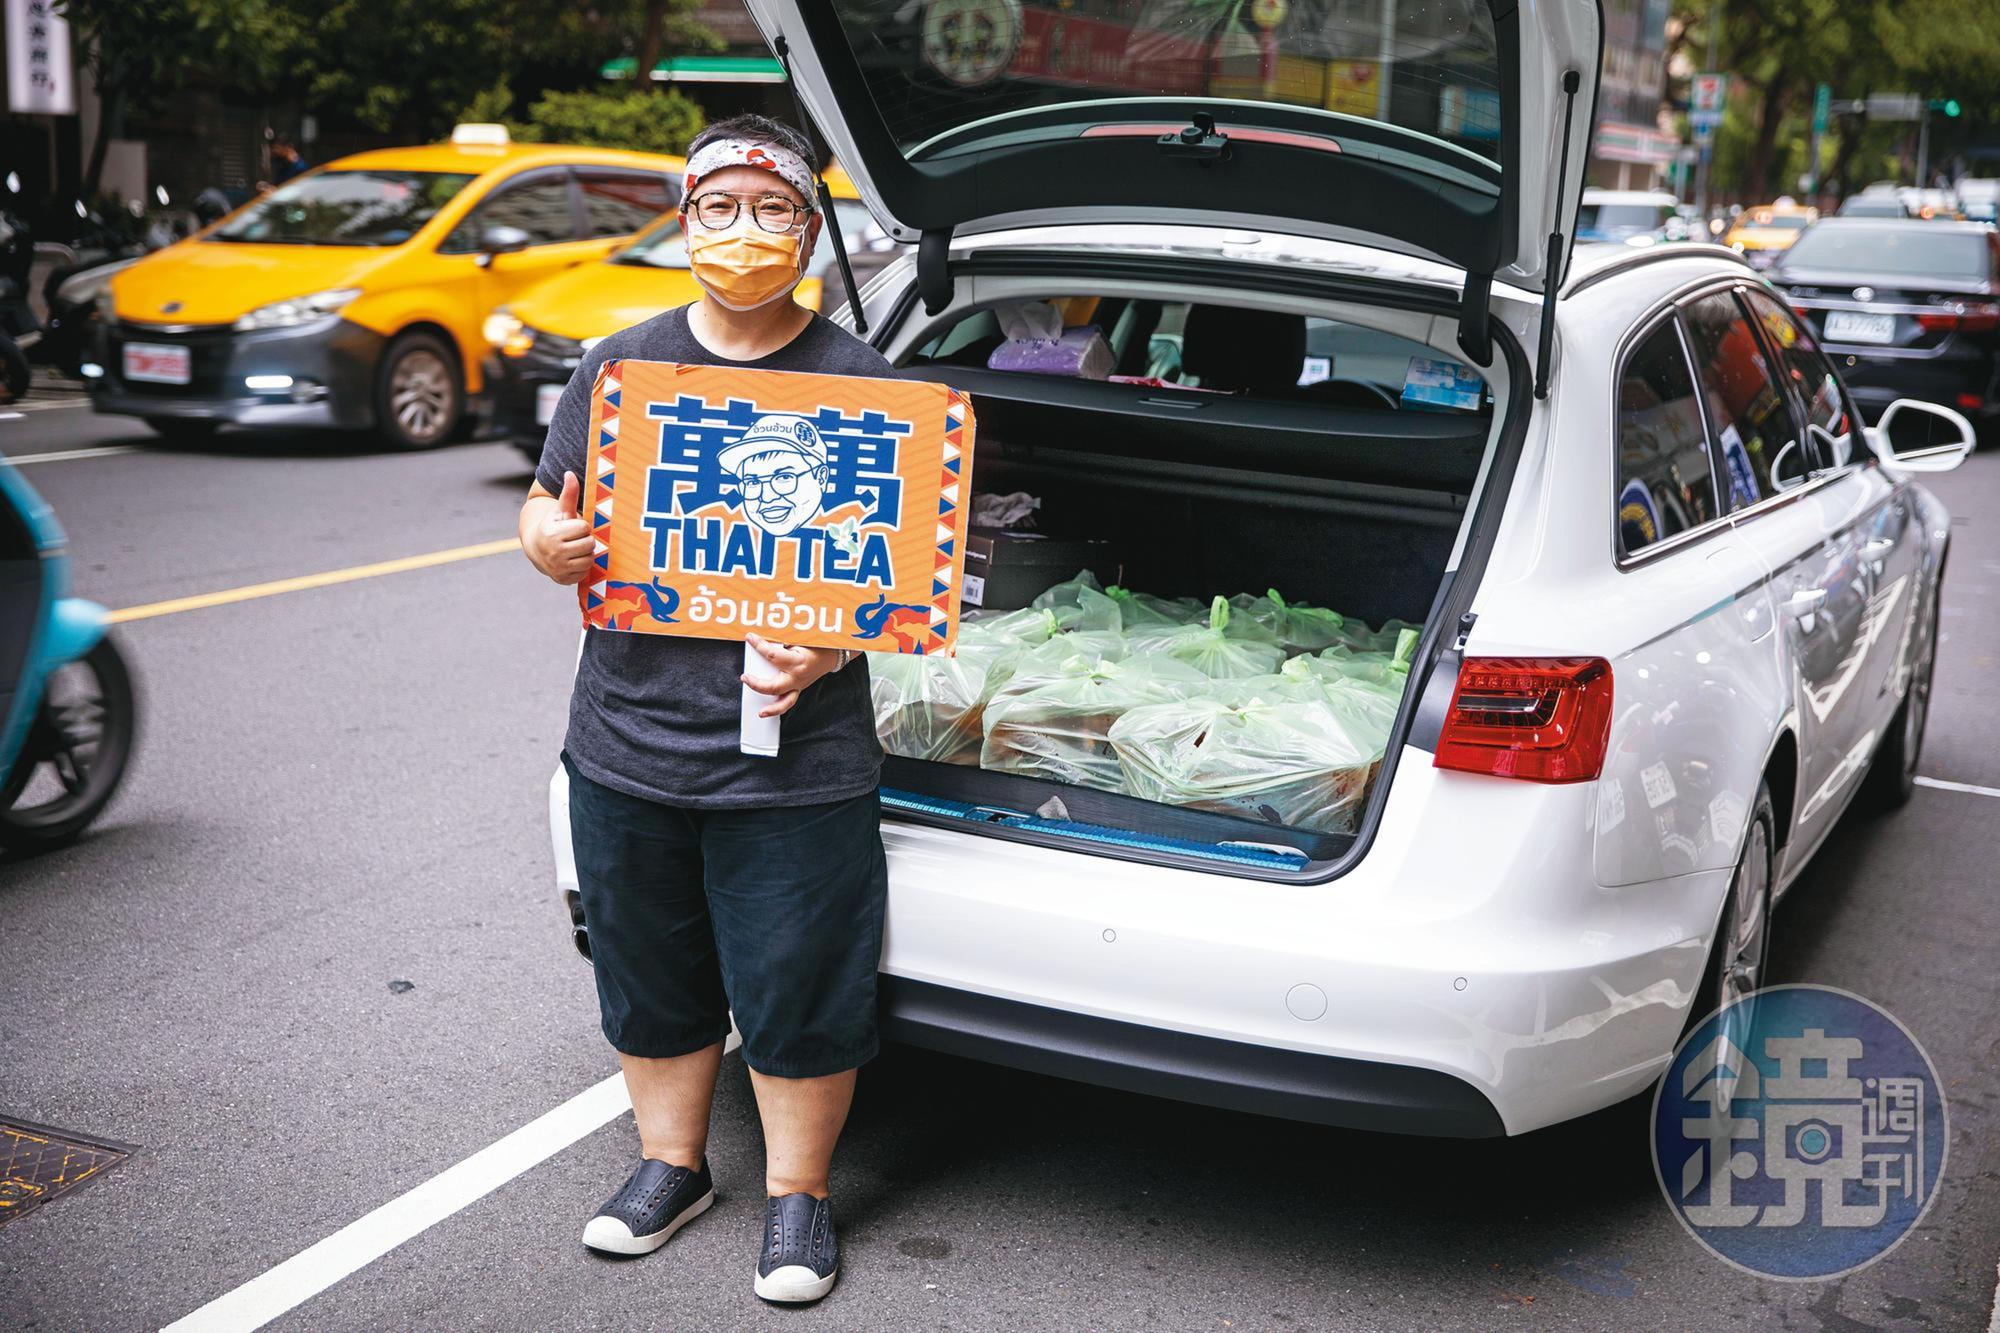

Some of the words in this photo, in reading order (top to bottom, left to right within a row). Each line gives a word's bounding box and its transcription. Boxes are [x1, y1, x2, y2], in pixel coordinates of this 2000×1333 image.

[643, 516, 776, 576] THAI
[787, 527, 893, 587] TEA
[688, 584, 843, 633] อ้วนอ้วน
